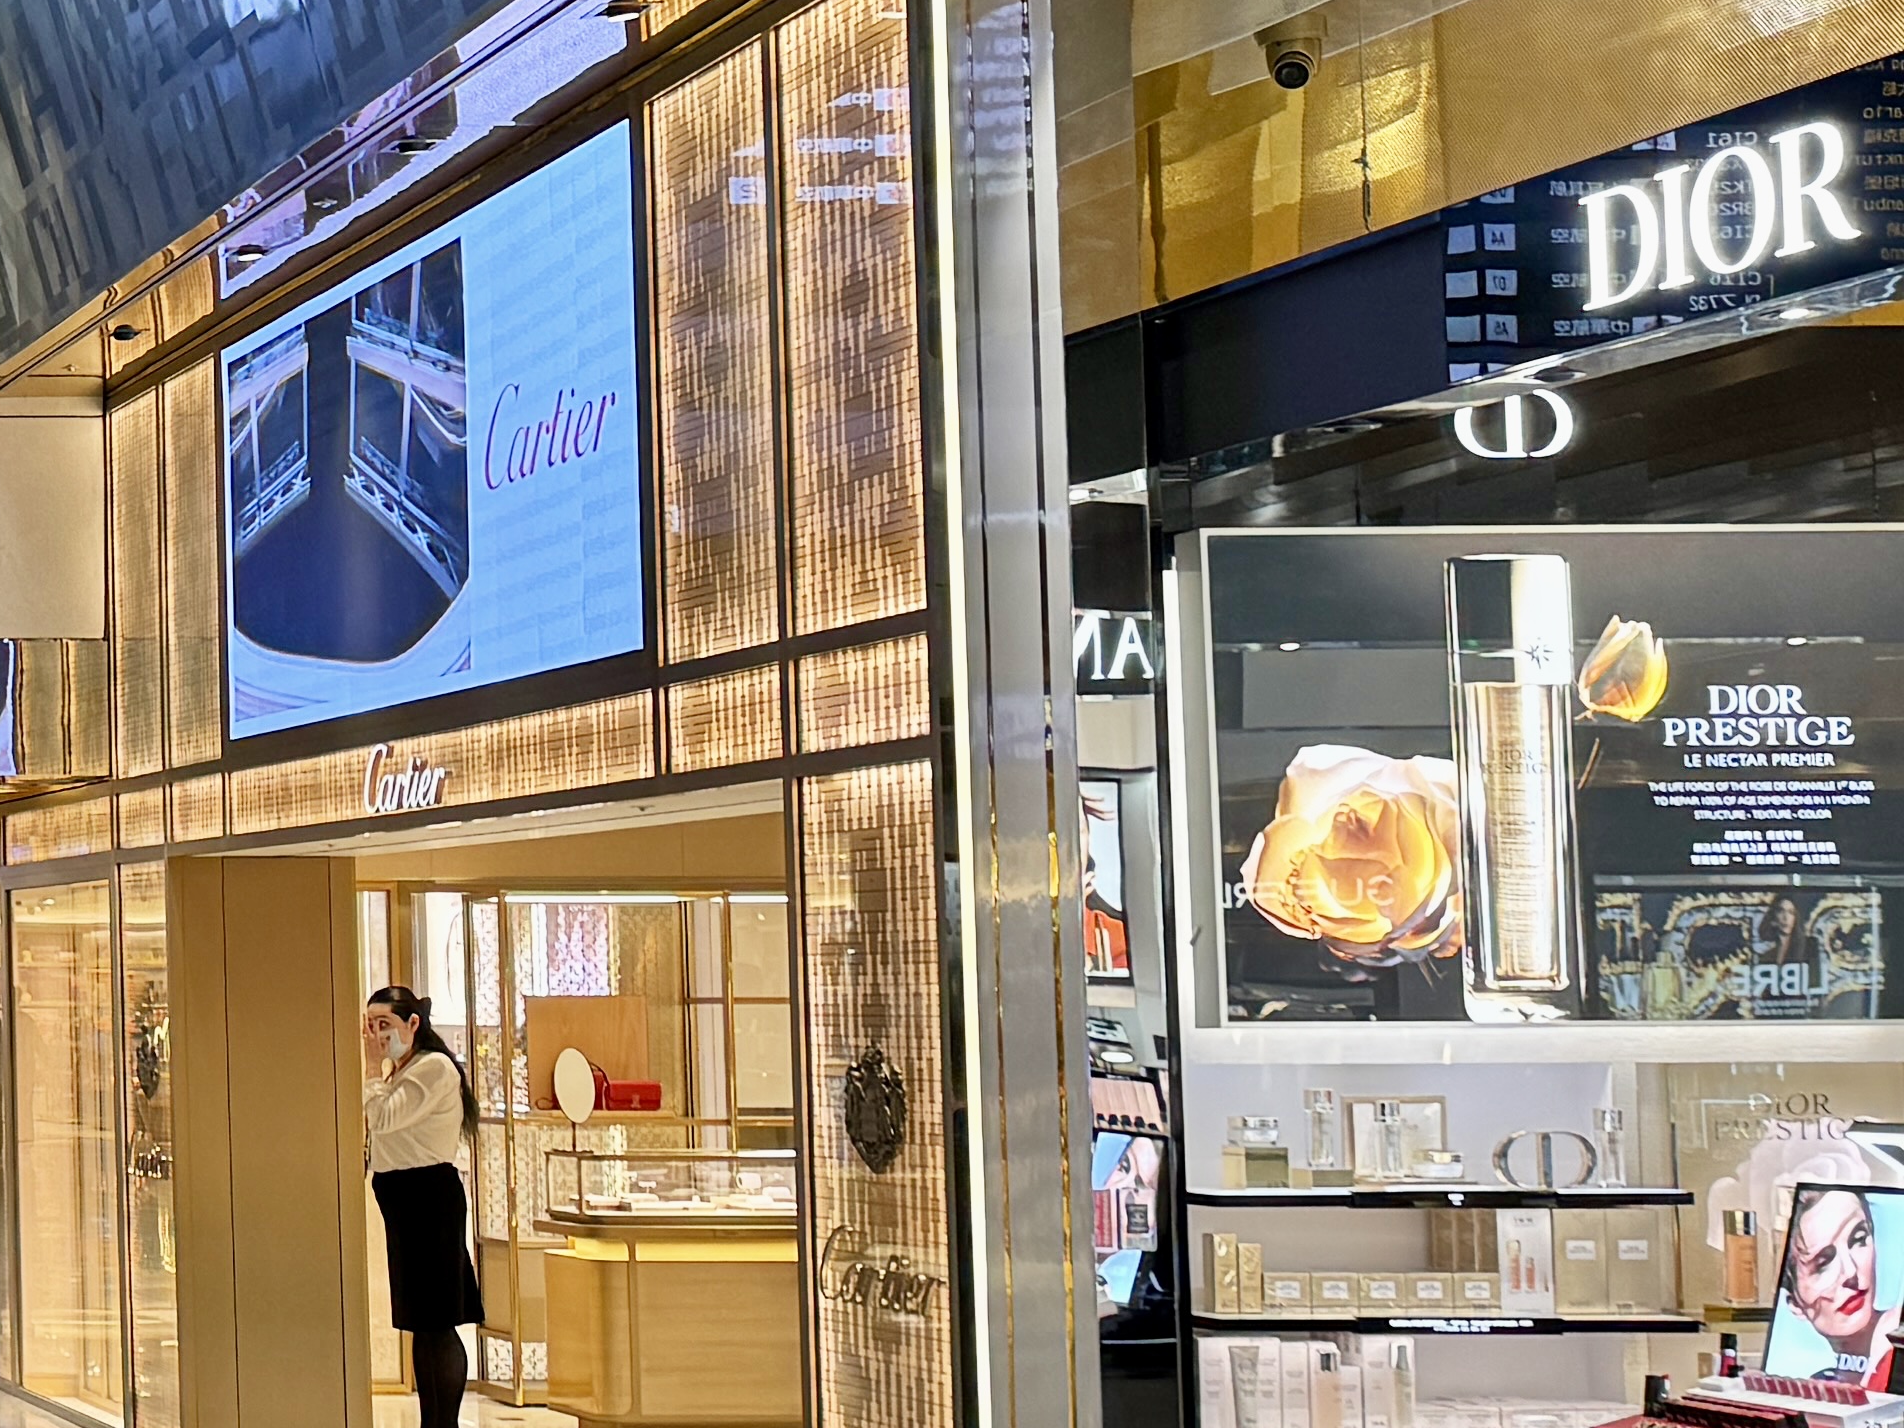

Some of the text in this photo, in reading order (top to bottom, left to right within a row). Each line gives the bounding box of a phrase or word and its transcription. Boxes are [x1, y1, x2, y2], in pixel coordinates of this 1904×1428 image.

[1578, 121, 1862, 312] DIOR
[483, 382, 617, 492] Cartier
[1707, 684, 1808, 716] DIOR
[1661, 716, 1856, 747] PRESTIGE
[1684, 752, 1836, 768] LE NECTAR PREMIER
[363, 743, 445, 816] Cartier
[1749, 1091, 1832, 1116] DIOR
[1714, 1117, 1848, 1141] PRESTIG
